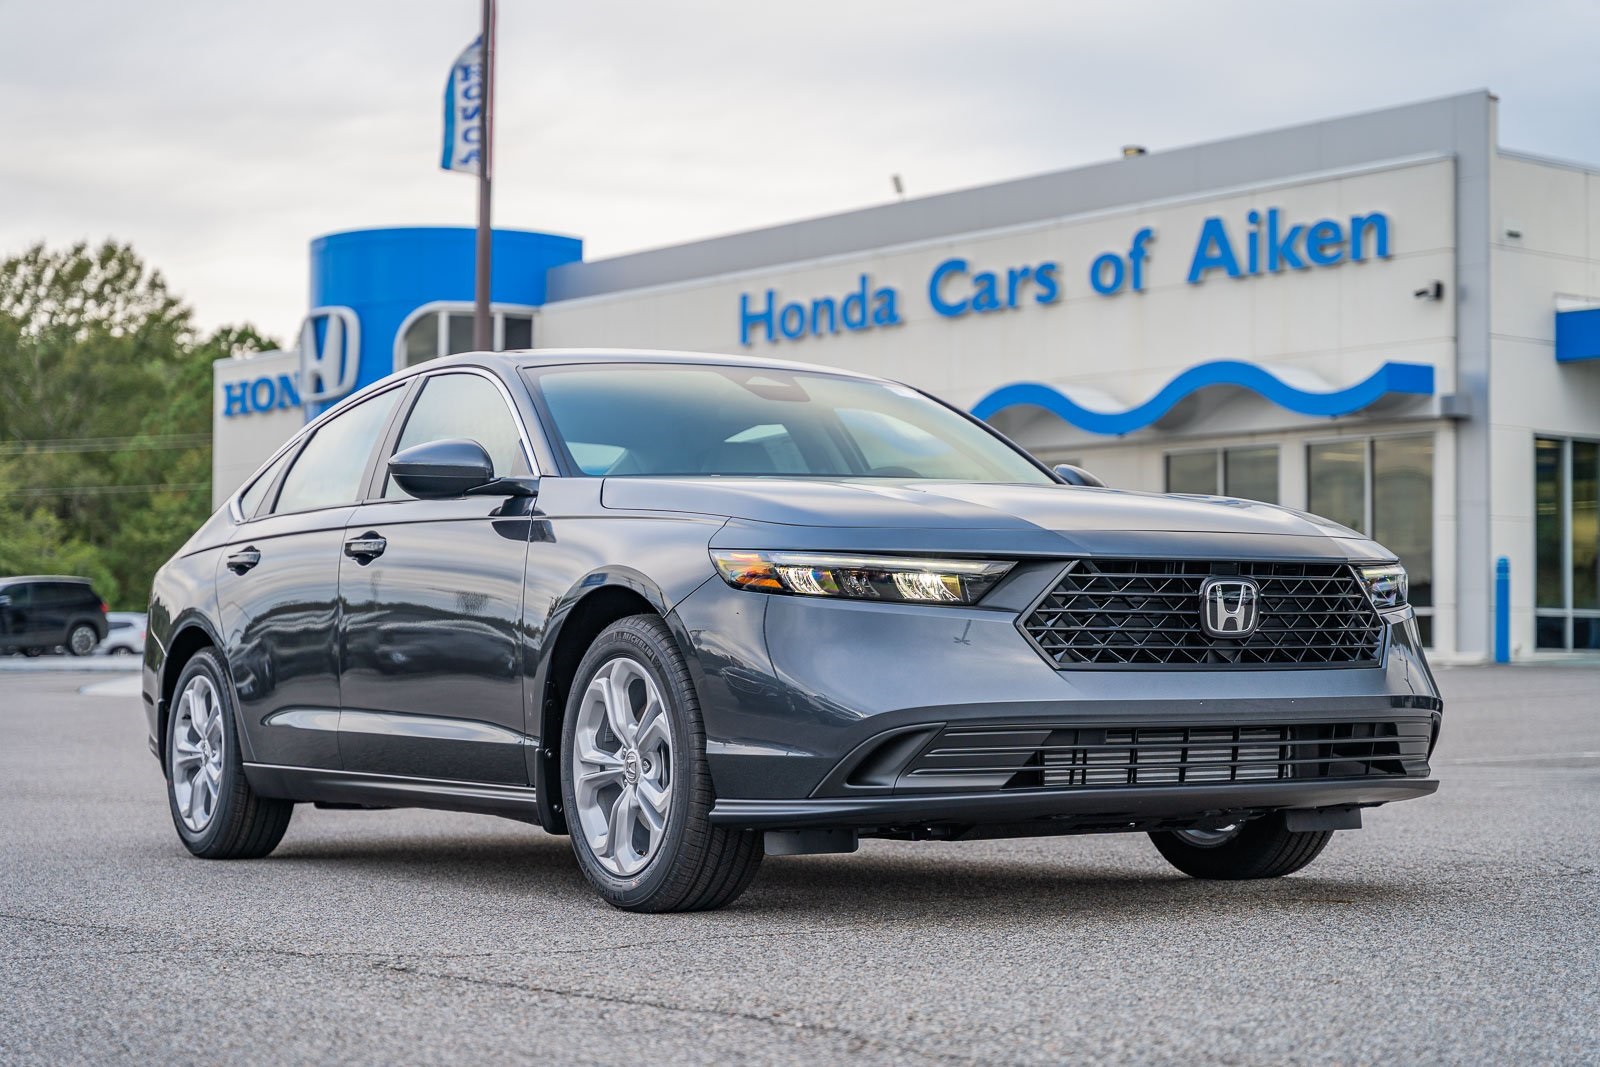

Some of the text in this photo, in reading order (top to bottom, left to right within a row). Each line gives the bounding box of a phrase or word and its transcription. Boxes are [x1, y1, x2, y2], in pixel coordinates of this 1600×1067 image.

[739, 207, 1390, 346] Honda Cars of Aiken
[223, 373, 303, 417] HON
[622, 632, 654, 658] MICHELIN
